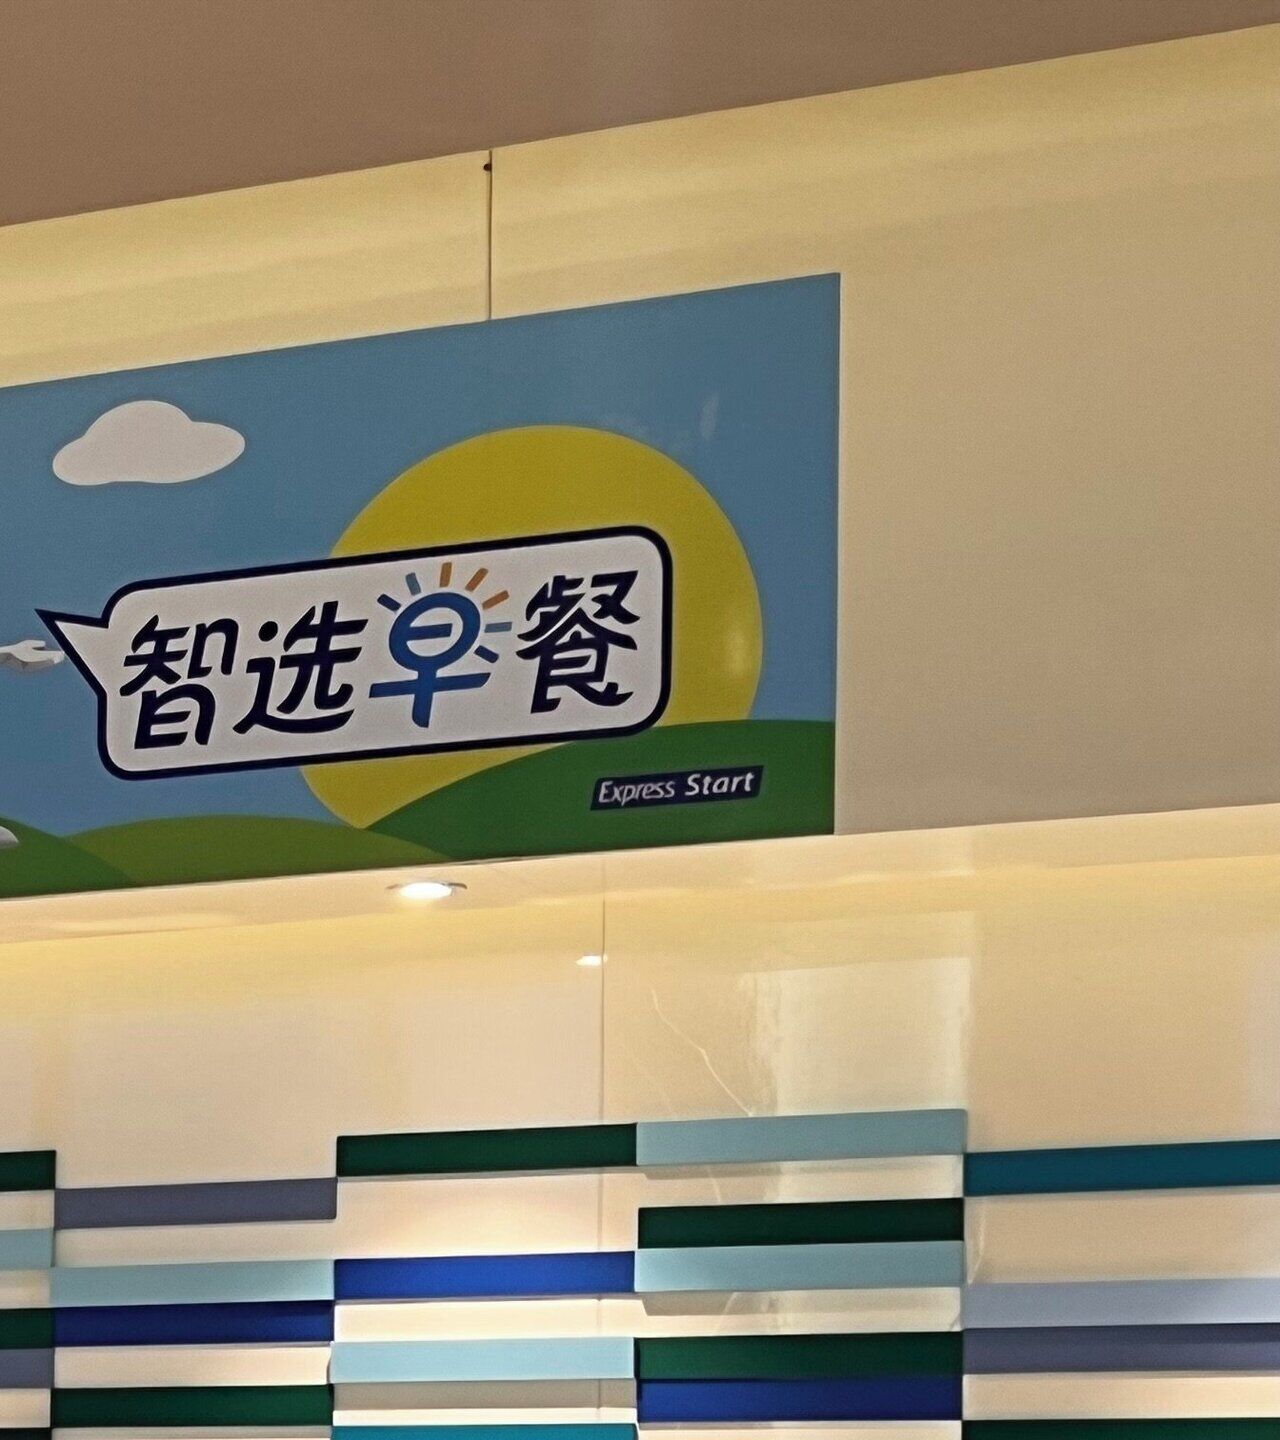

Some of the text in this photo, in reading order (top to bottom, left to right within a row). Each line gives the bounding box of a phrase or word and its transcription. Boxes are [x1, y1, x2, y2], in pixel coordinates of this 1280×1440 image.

[119, 568, 642, 749] 智选早餐
[598, 772, 755, 807] Express Start
